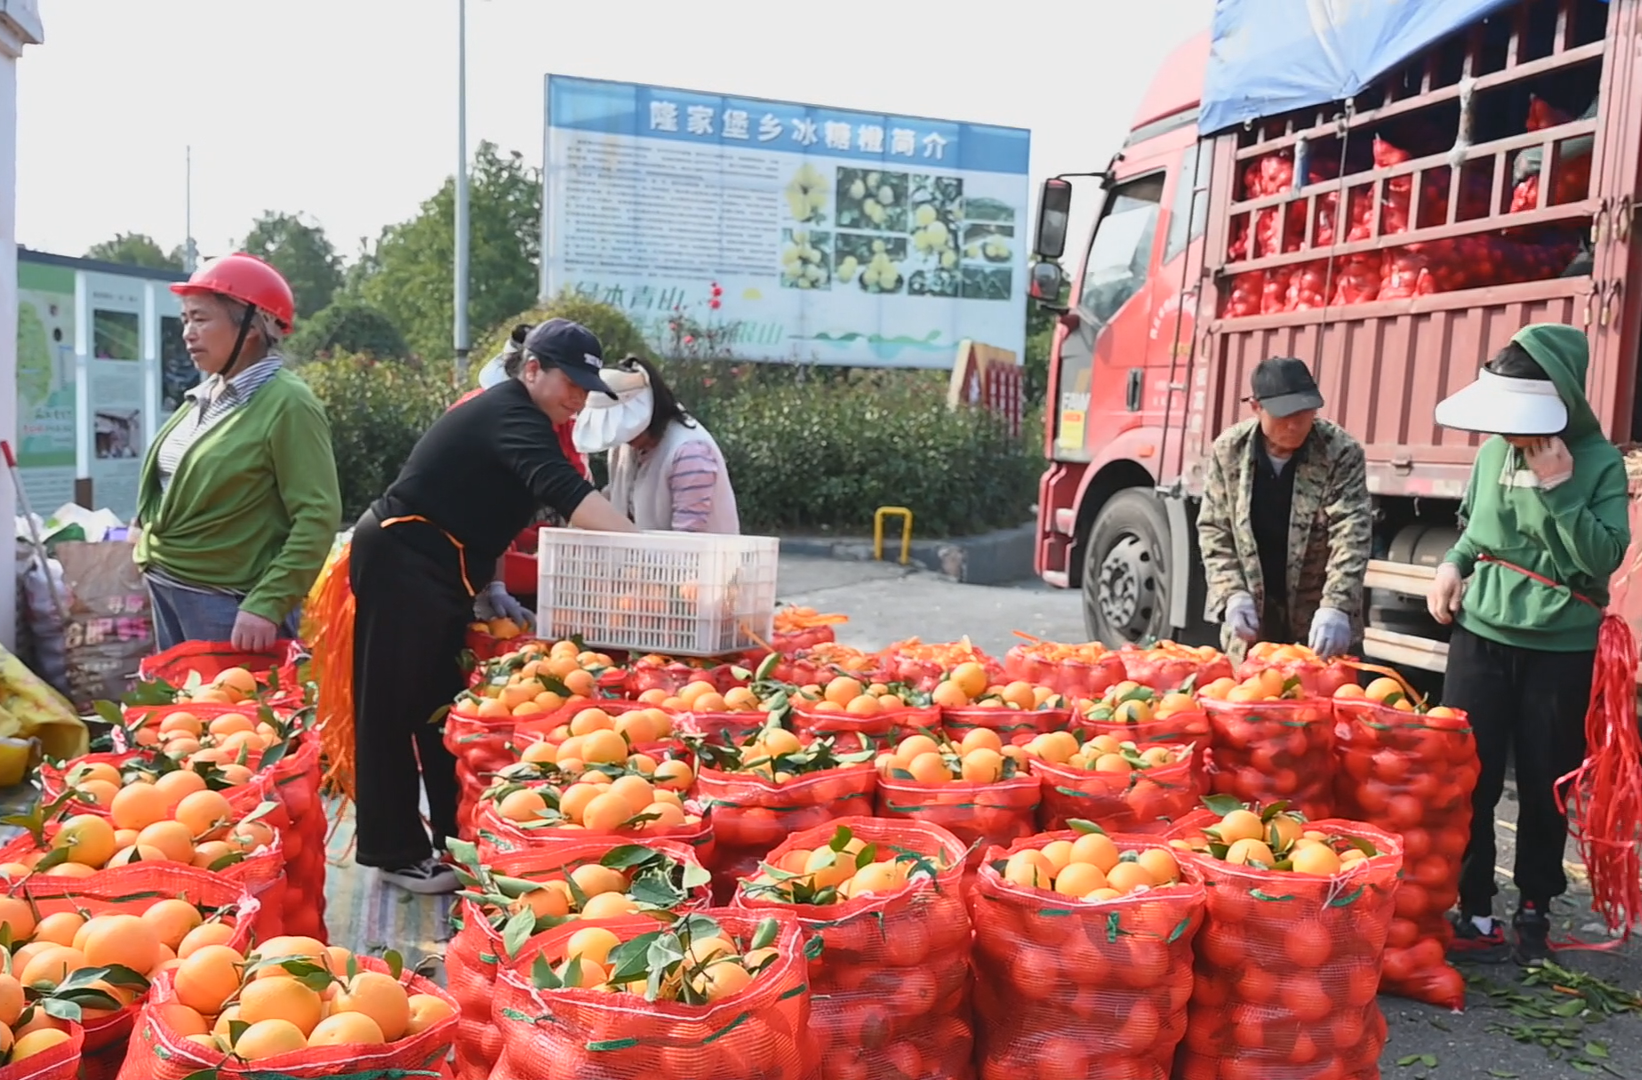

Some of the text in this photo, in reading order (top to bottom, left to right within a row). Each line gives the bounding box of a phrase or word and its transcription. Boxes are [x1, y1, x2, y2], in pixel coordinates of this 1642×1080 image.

[650, 100, 948, 160] 隆家堡乡冰糖橙简介
